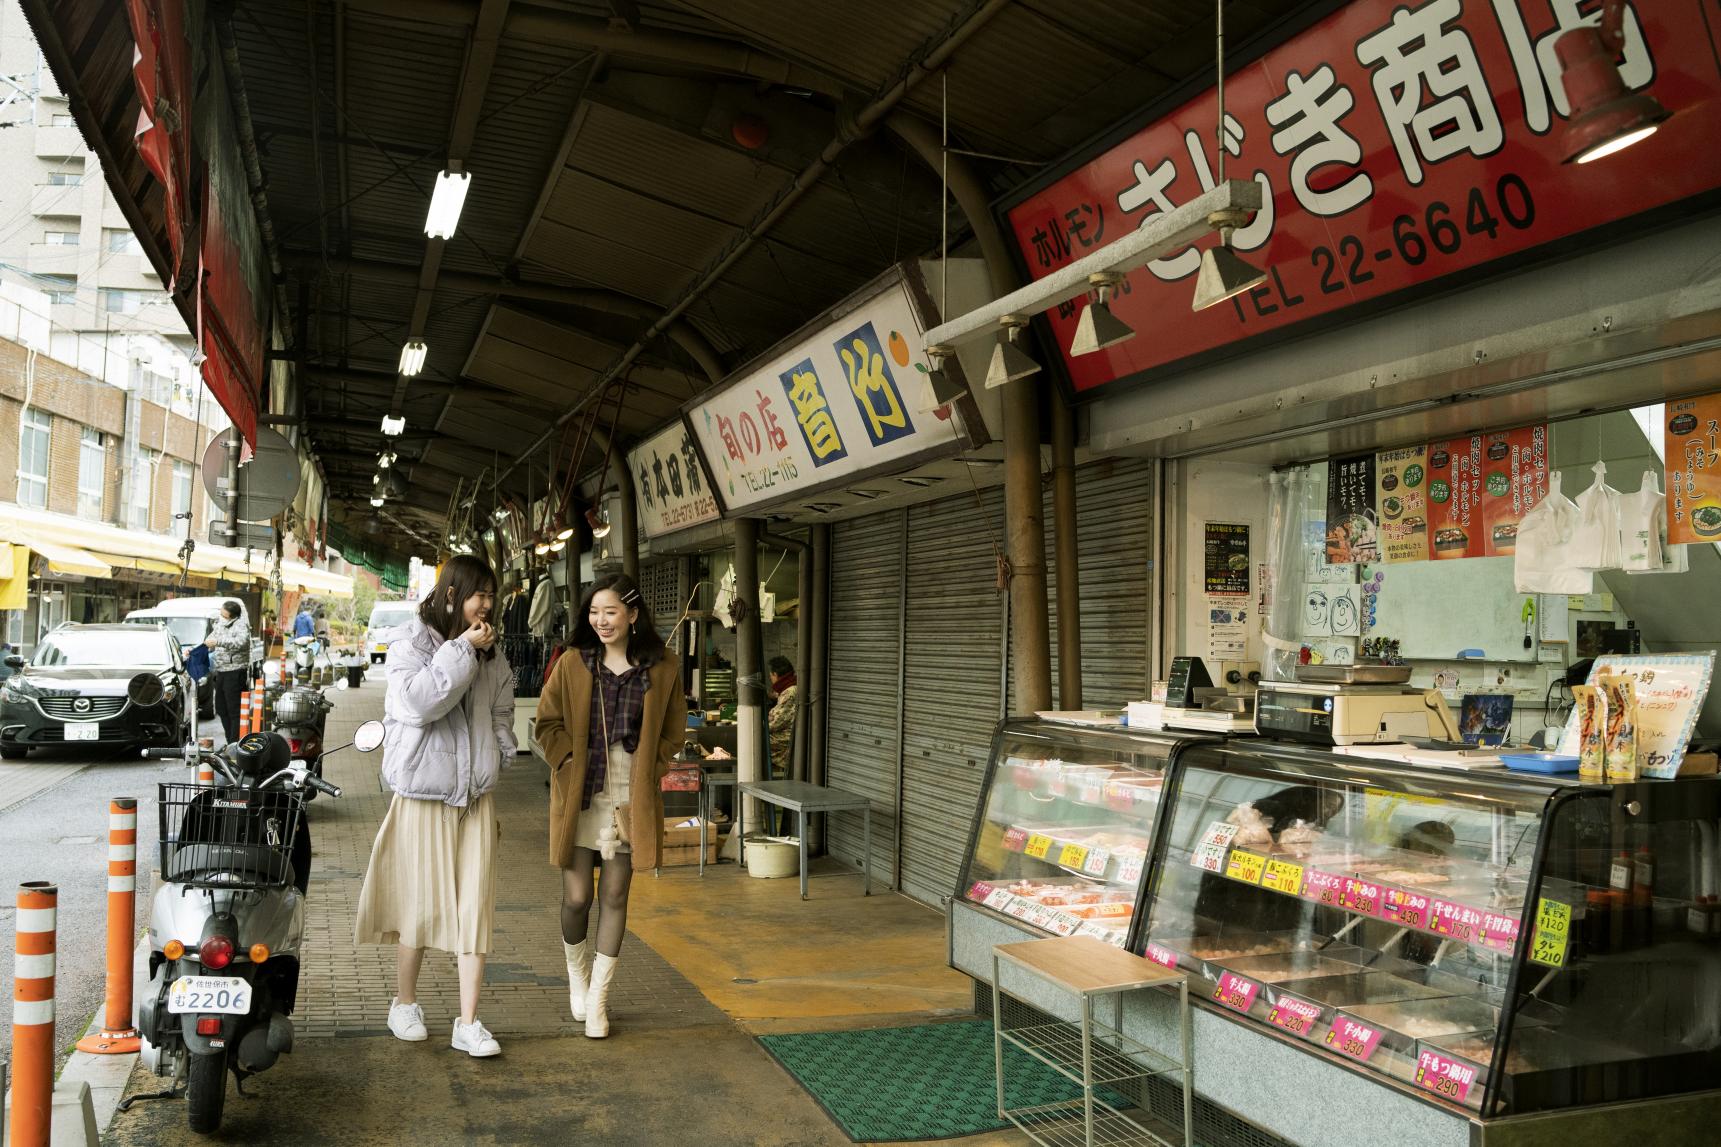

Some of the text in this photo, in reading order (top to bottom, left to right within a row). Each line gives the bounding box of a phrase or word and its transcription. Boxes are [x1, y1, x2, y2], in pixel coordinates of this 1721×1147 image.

[1032, 203, 1104, 267] ホルモン
[1312, 173, 1536, 293] 22-6640
[716, 388, 789, 465] 旬の店
[1471, 436, 1481, 506] 焼肉セット
[1533, 427, 1545, 500] 焼肉セット
[1674, 472, 1683, 521] あります
[1242, 868, 1255, 879] 100
[1308, 872, 1340, 889] 牛こぶくろ
[1280, 878, 1293, 891] 110
[1345, 880, 1377, 898] 牛中みの
[1355, 897, 1373, 912] 230
[1434, 901, 1480, 924] 牛せんまい
[1400, 910, 1419, 925] 430
[1541, 916, 1564, 932] ¥120
[1451, 922, 1472, 938] 170
[1539, 940, 1556, 950] タレ
[1534, 948, 1562, 964] ¥210
[196, 979, 229, 989] 佐世保市
[188, 990, 246, 1010] 2206
[1228, 993, 1246, 1008] 330
[1285, 1015, 1304, 1031] 220
[1343, 1039, 1365, 1056] 330
[1421, 1052, 1473, 1085] 牛もつ鍋用
[1436, 1076, 1460, 1097] 290
